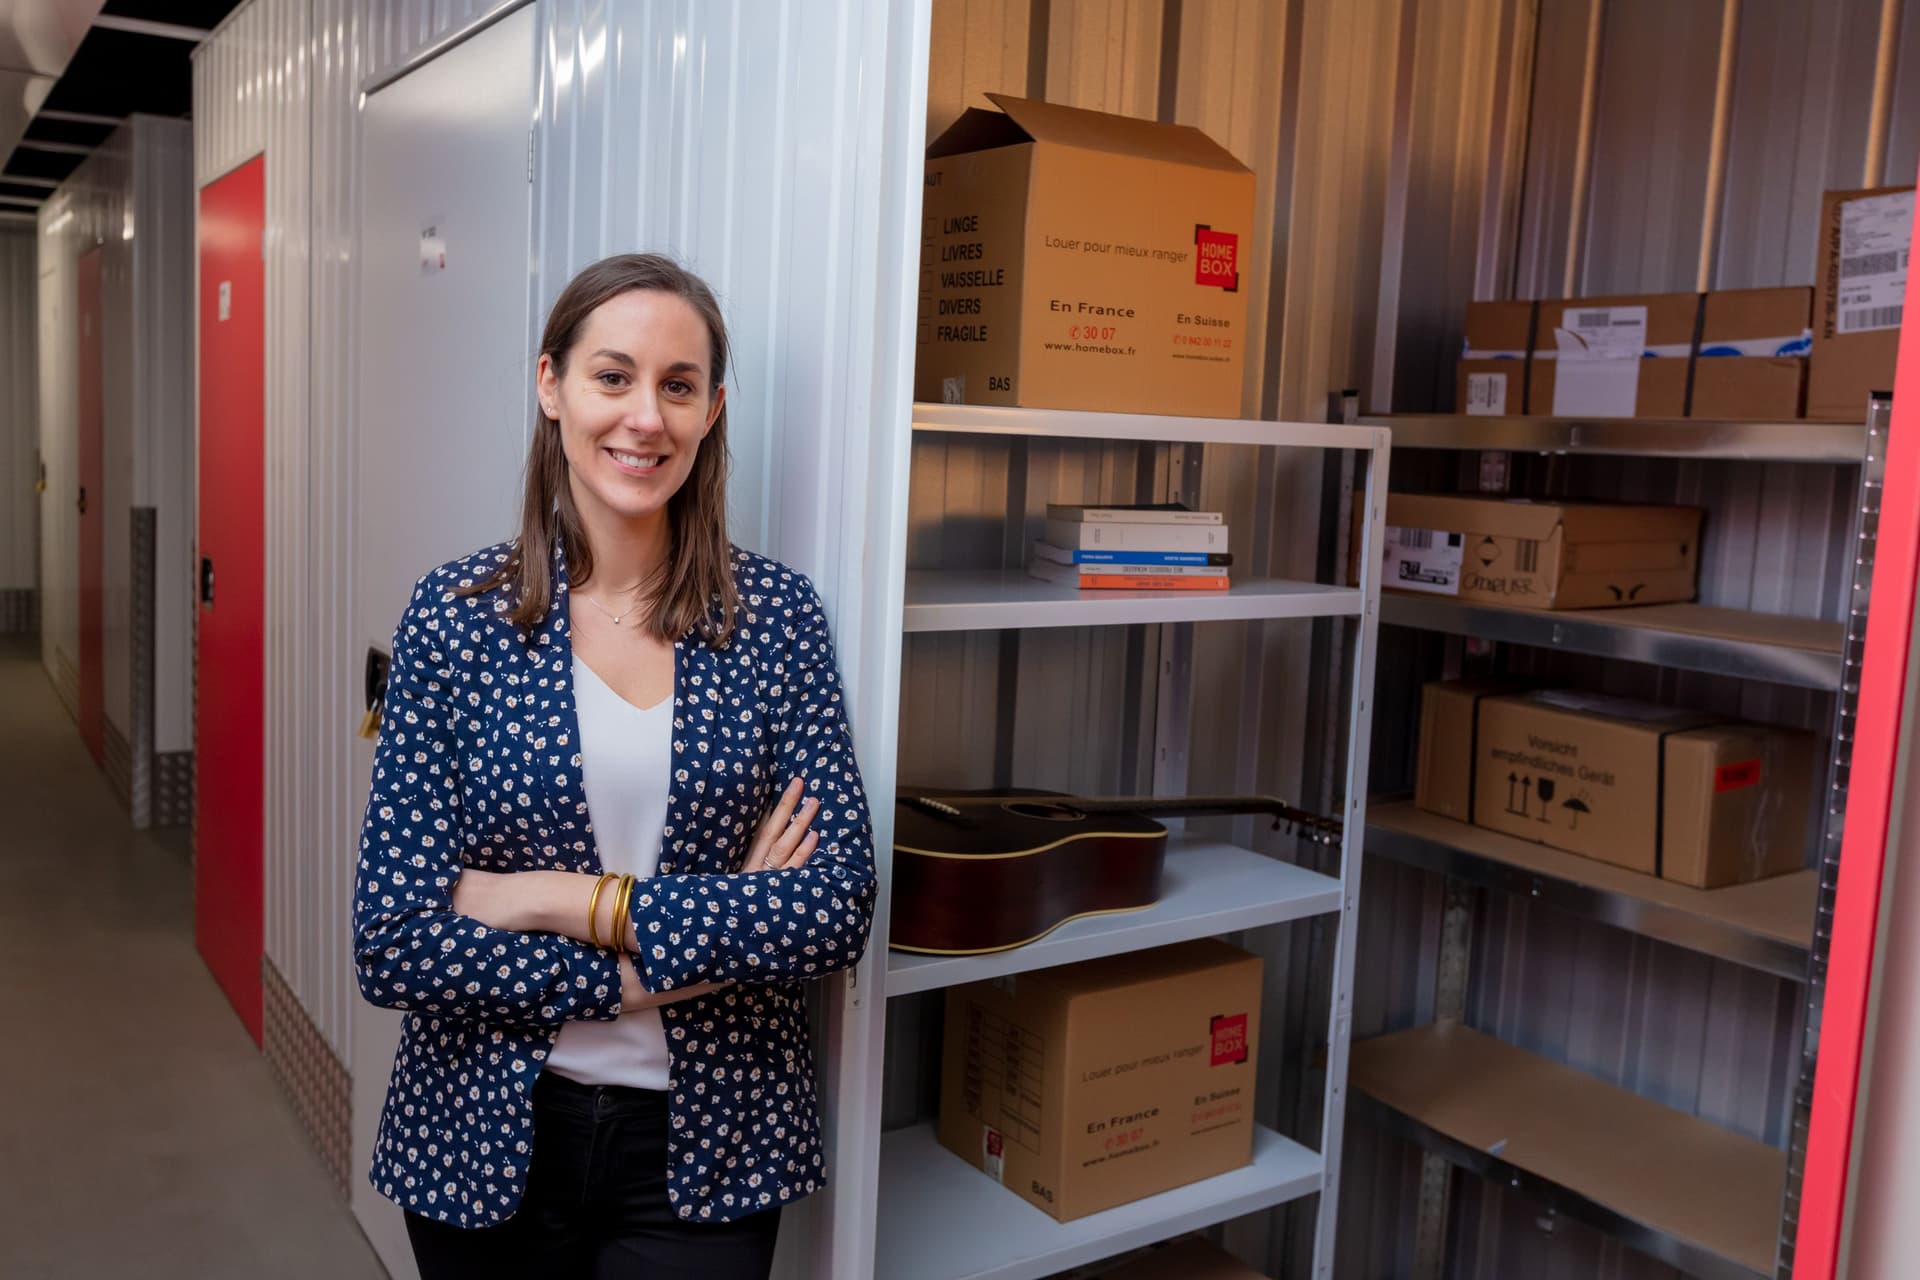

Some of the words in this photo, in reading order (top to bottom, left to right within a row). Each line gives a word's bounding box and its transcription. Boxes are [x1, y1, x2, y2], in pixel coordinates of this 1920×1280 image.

[943, 215, 978, 234] LINGE
[941, 243, 983, 262] LIVRES
[1045, 235, 1080, 250] Louer
[1083, 240, 1111, 253] pour
[1114, 243, 1149, 257] mieux
[1152, 249, 1188, 263] ranger
[1201, 242, 1233, 260] HOME
[1200, 259, 1232, 276] BOX
[941, 269, 1004, 288] VAISSELLE
[938, 298, 981, 315] DIVERS
[1050, 300, 1072, 313] En
[1078, 302, 1135, 318] France
[1177, 313, 1191, 325] En
[1194, 315, 1230, 328] Suisse
[937, 325, 987, 342] FRAGILE
[1083, 326, 1098, 340] 30
[1102, 327, 1116, 340] 07
[1044, 343, 1136, 356] www.homebox.fr
[989, 377, 1010, 392] BAS
[1527, 734, 1578, 757] Vorsicht
[1215, 1038, 1243, 1056] BOX
[1081, 1067, 1112, 1083] Louer
[1115, 1061, 1139, 1075] pour
[1141, 1053, 1170, 1067] mieux
[1087, 1122, 1105, 1134] En
[1110, 1108, 1159, 1128] France
[1032, 1181, 1053, 1203] BAS
